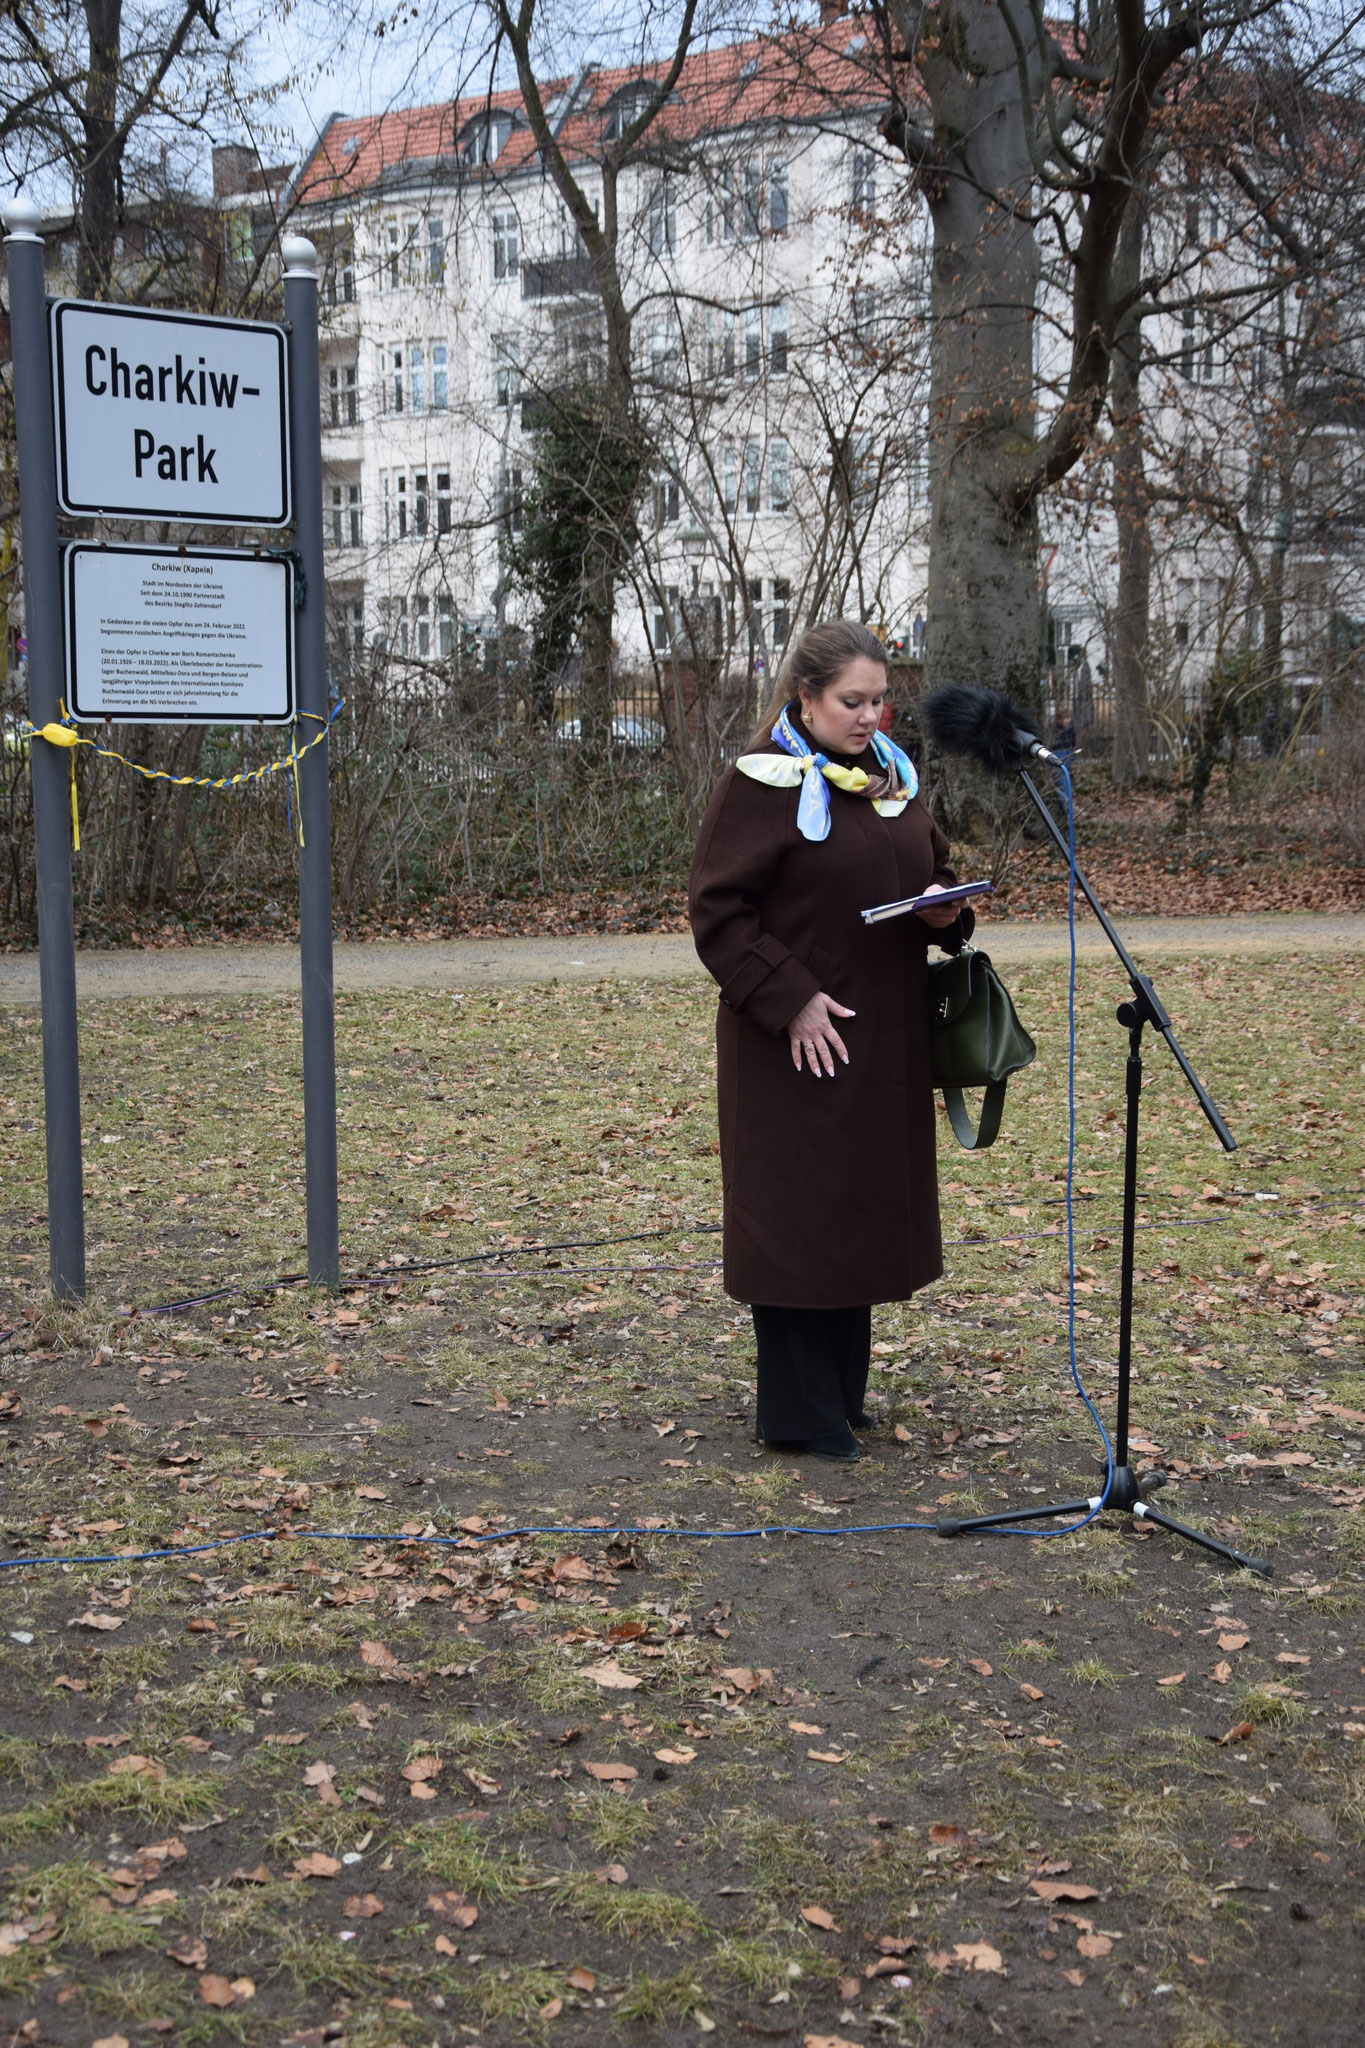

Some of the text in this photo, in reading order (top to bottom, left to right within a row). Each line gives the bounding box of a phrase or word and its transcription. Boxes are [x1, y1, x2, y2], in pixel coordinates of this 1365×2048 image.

[85, 344, 260, 408] Charkiw-
[134, 428, 219, 484] Park
[152, 563, 182, 572] Charkiw
